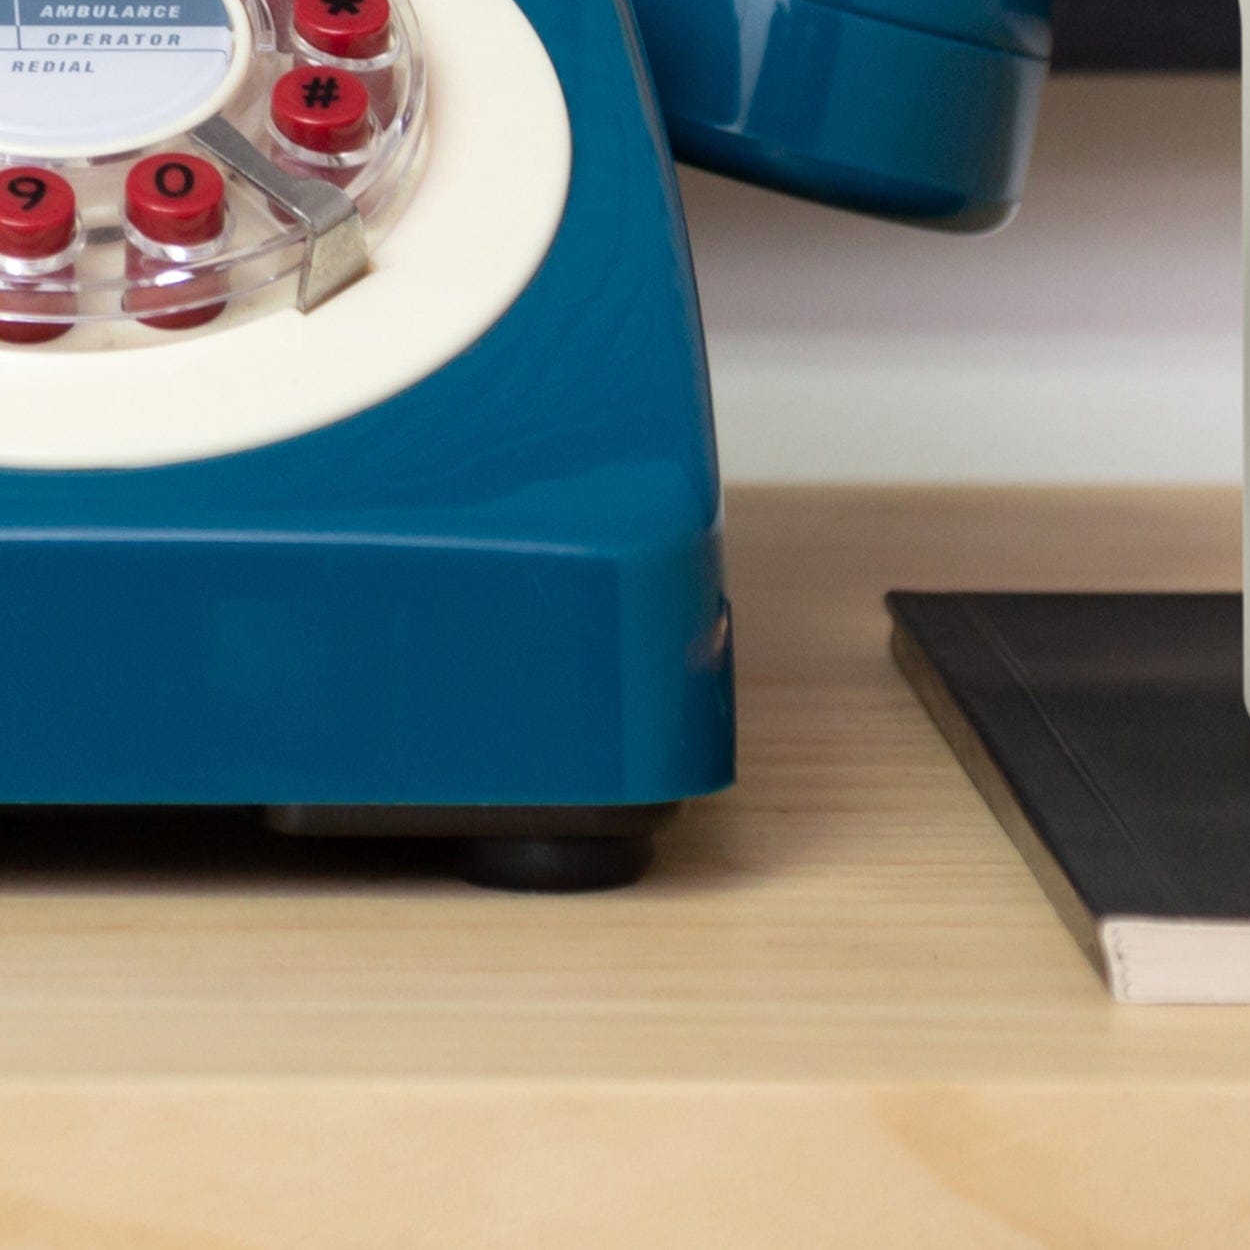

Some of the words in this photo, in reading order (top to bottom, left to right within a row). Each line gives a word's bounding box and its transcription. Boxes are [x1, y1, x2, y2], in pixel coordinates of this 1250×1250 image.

[40, 5, 181, 19] AMBULANCE
[47, 32, 181, 47] OPERATOR
[11, 60, 95, 74] REDIAL
[302, 76, 339, 109] #
[6, 176, 47, 211] 9
